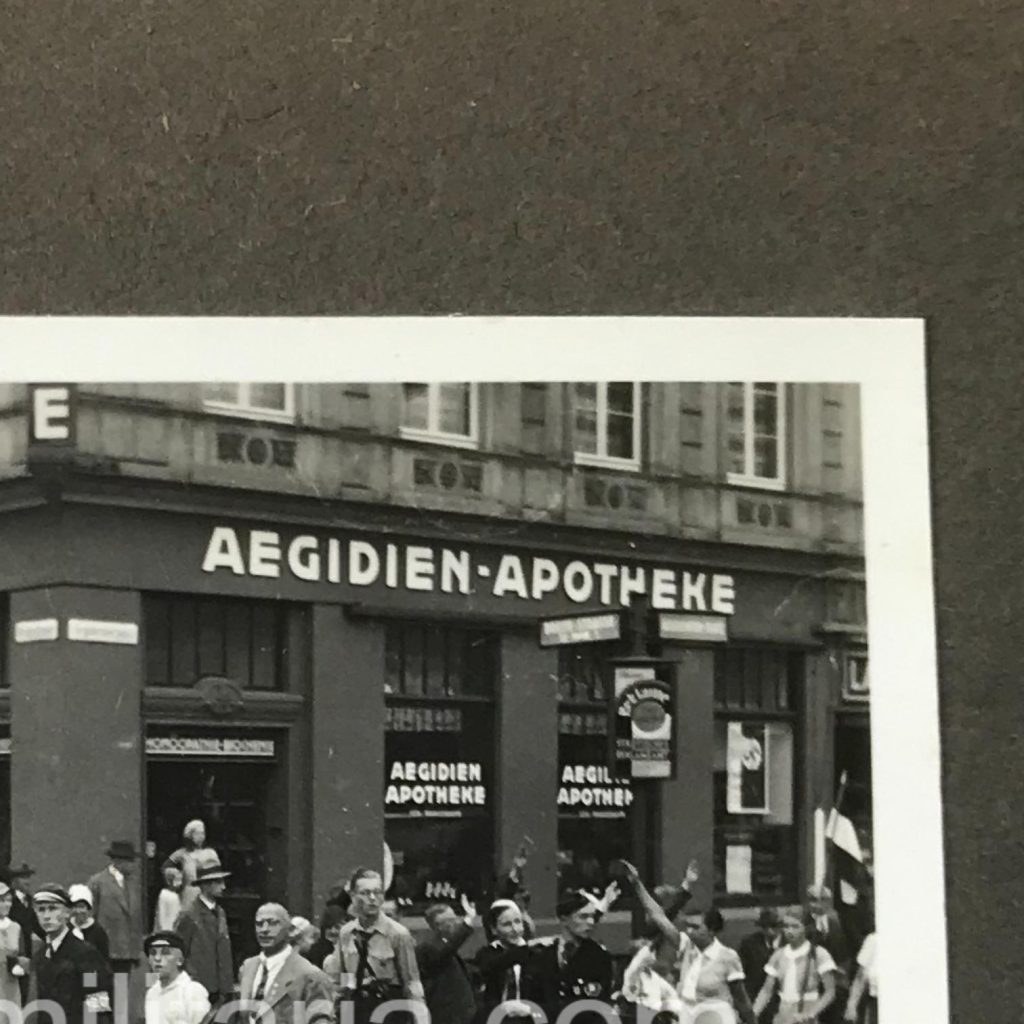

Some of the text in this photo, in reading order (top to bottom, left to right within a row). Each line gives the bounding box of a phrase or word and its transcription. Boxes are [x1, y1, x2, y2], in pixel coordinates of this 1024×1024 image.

[33, 388, 70, 439] E
[202, 525, 736, 615] AEGIDIEN-APOTHEKE
[390, 761, 482, 782] AEGIDIEN
[385, 785, 486, 805] APOTHEKE
